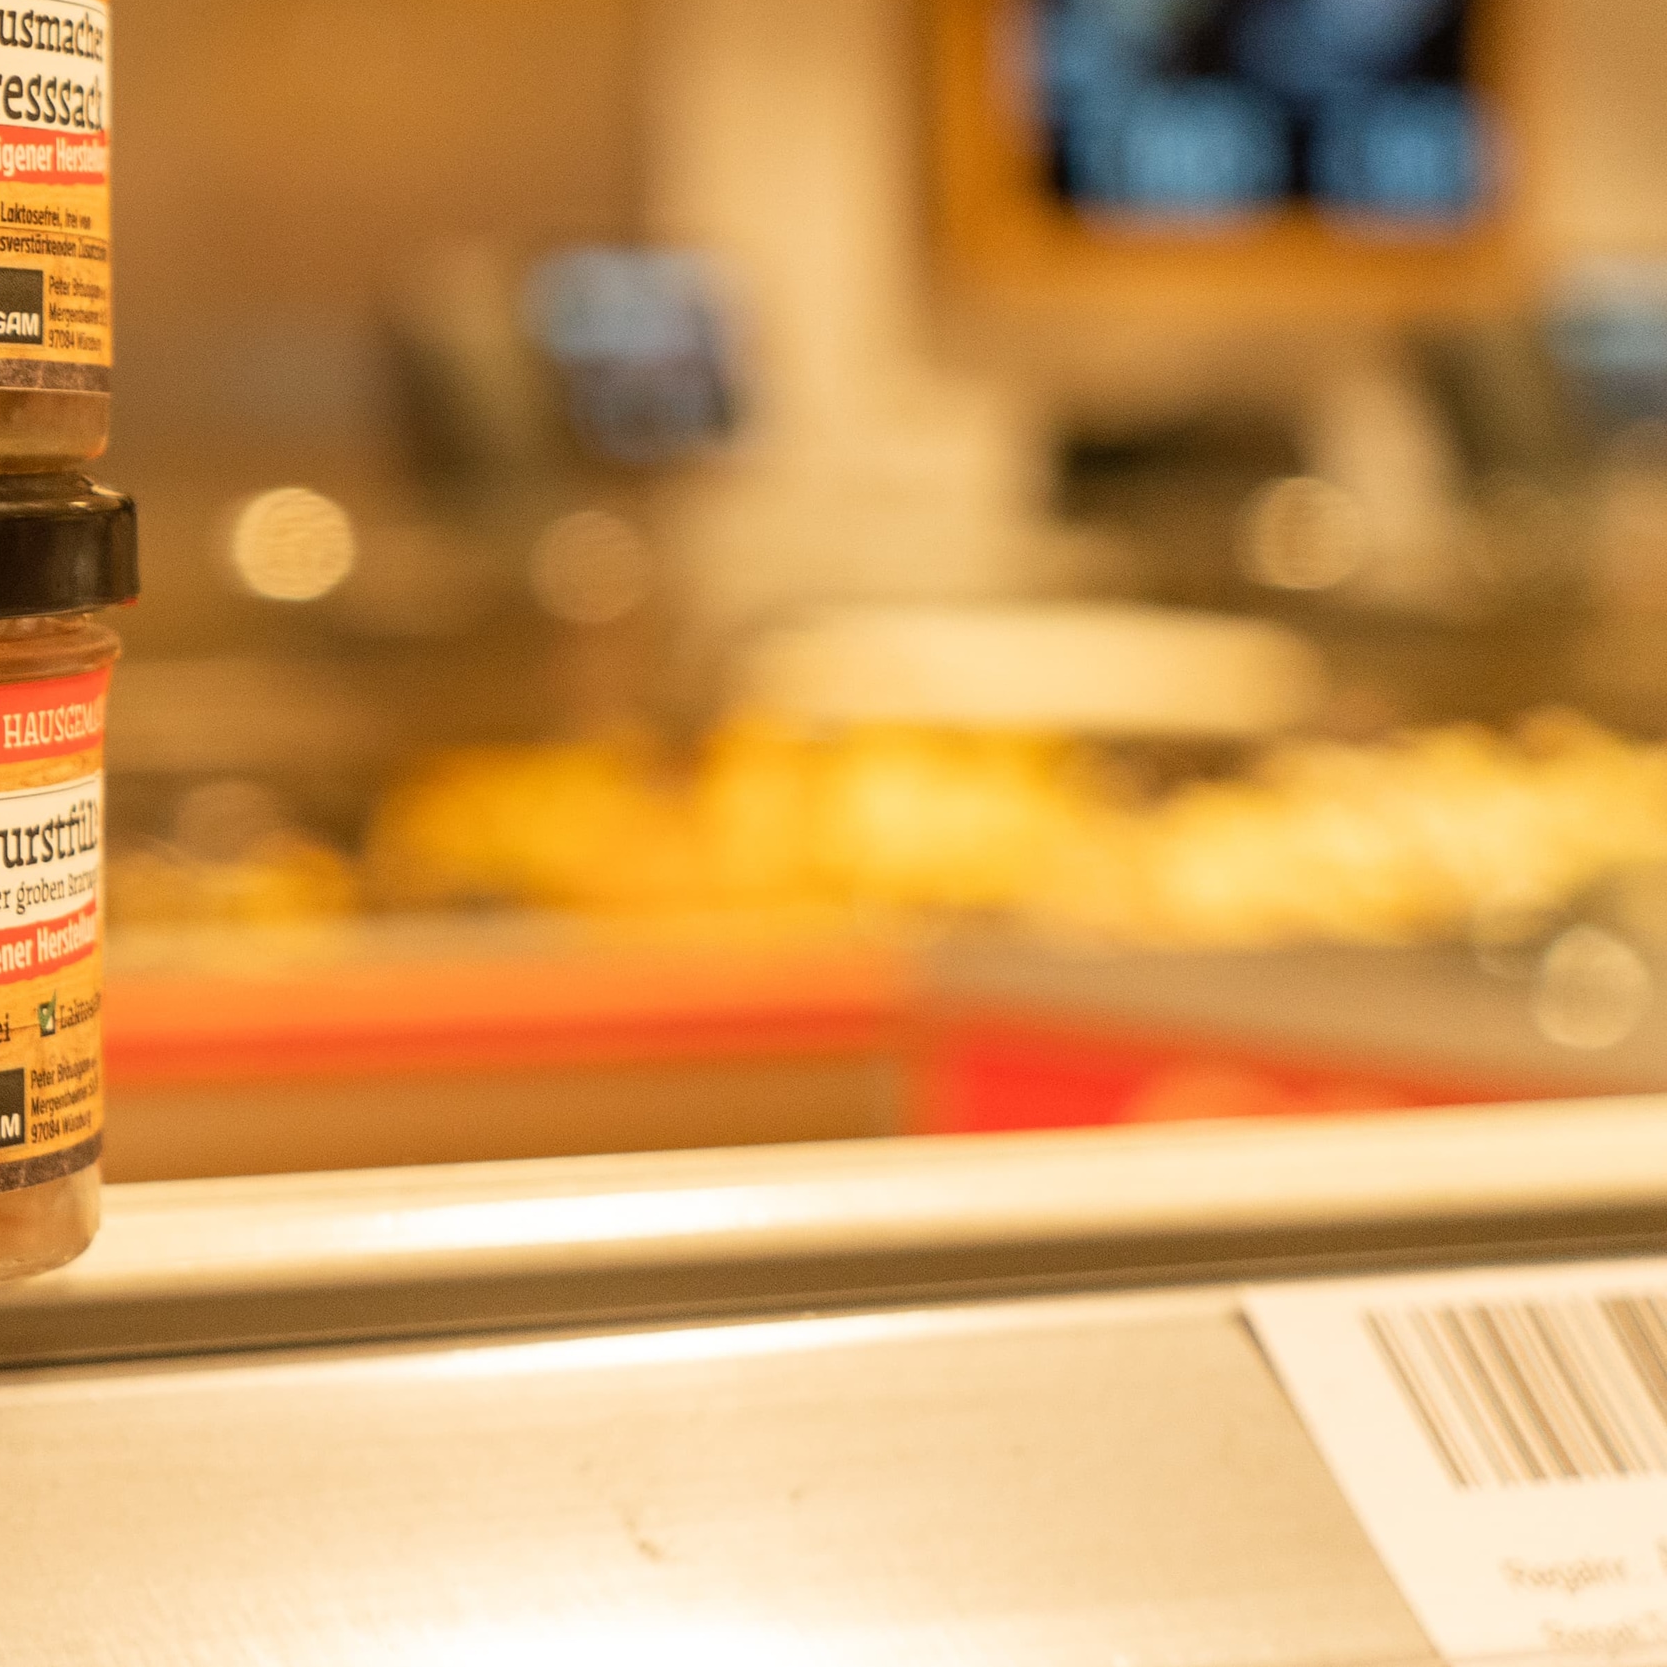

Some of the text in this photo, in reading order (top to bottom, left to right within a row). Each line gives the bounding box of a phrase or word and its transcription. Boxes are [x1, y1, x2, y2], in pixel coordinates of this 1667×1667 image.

[0, 200, 63, 230] Laktosefrei,
[15, 874, 65, 915] groben
[31, 1118, 61, 1144] 97084
